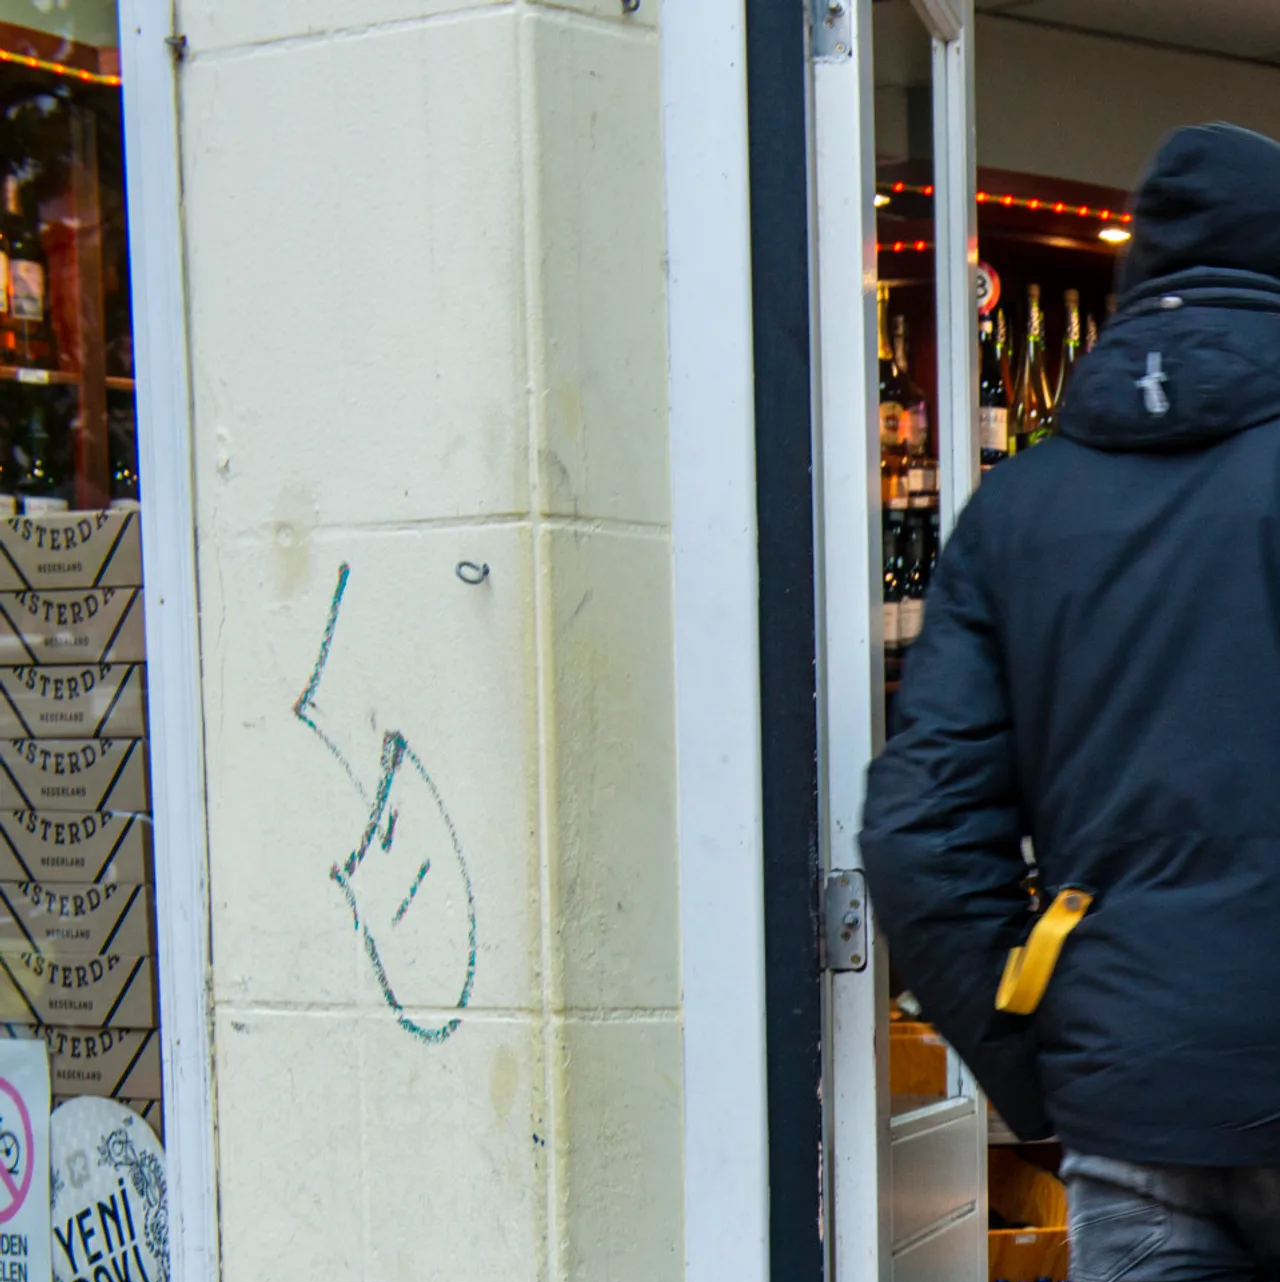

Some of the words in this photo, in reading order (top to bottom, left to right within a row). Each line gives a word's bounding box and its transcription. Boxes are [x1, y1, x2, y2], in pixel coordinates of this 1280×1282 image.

[37, 561, 83, 573] NEDERLAND
[40, 711, 84, 723] NEDERLAND
[41, 786, 86, 797] NEDERLAND
[40, 856, 85, 867] NEDERLAND
[48, 1000, 93, 1010] NEDERLAND
[56, 1070, 101, 1081] NEDERLAND
